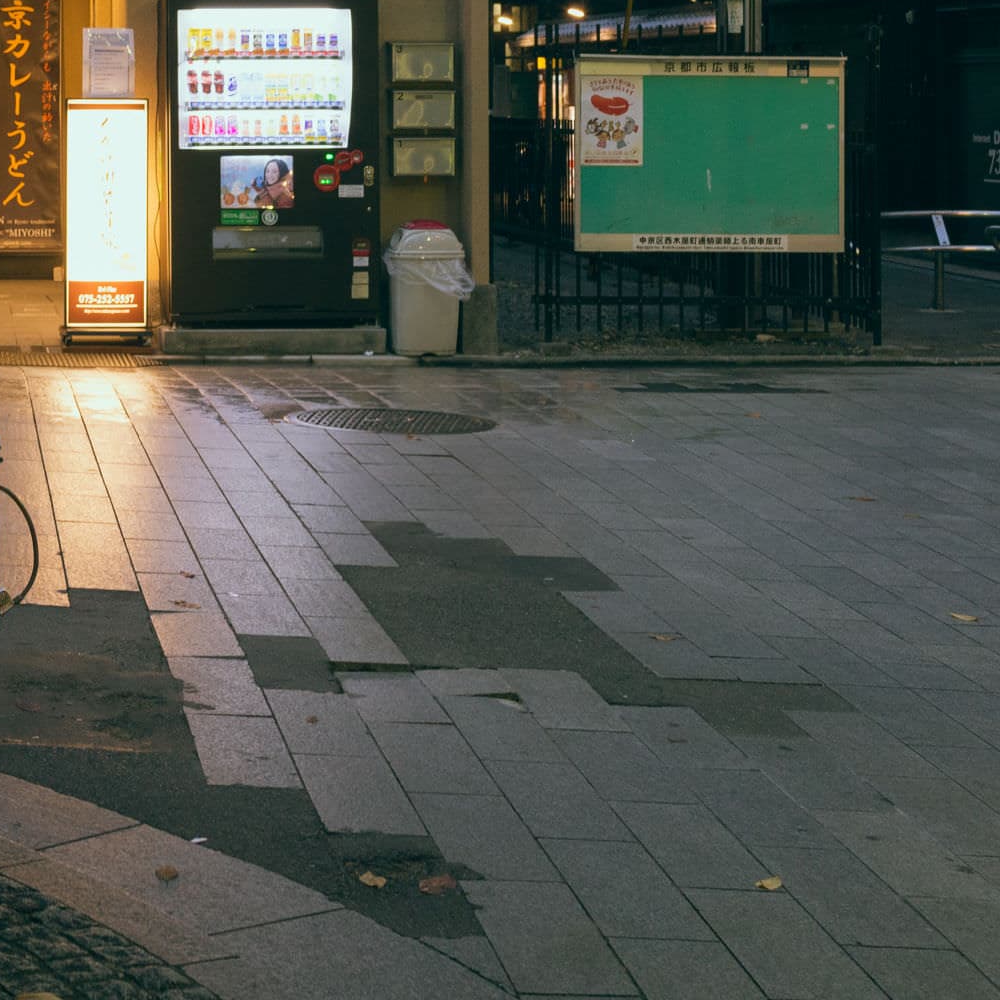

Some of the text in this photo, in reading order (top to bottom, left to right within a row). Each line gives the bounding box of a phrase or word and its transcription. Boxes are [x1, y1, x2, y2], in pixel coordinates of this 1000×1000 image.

[0, 0, 35, 207] 京カレーうどん
[664, 61, 756, 73] 京都市広報板
